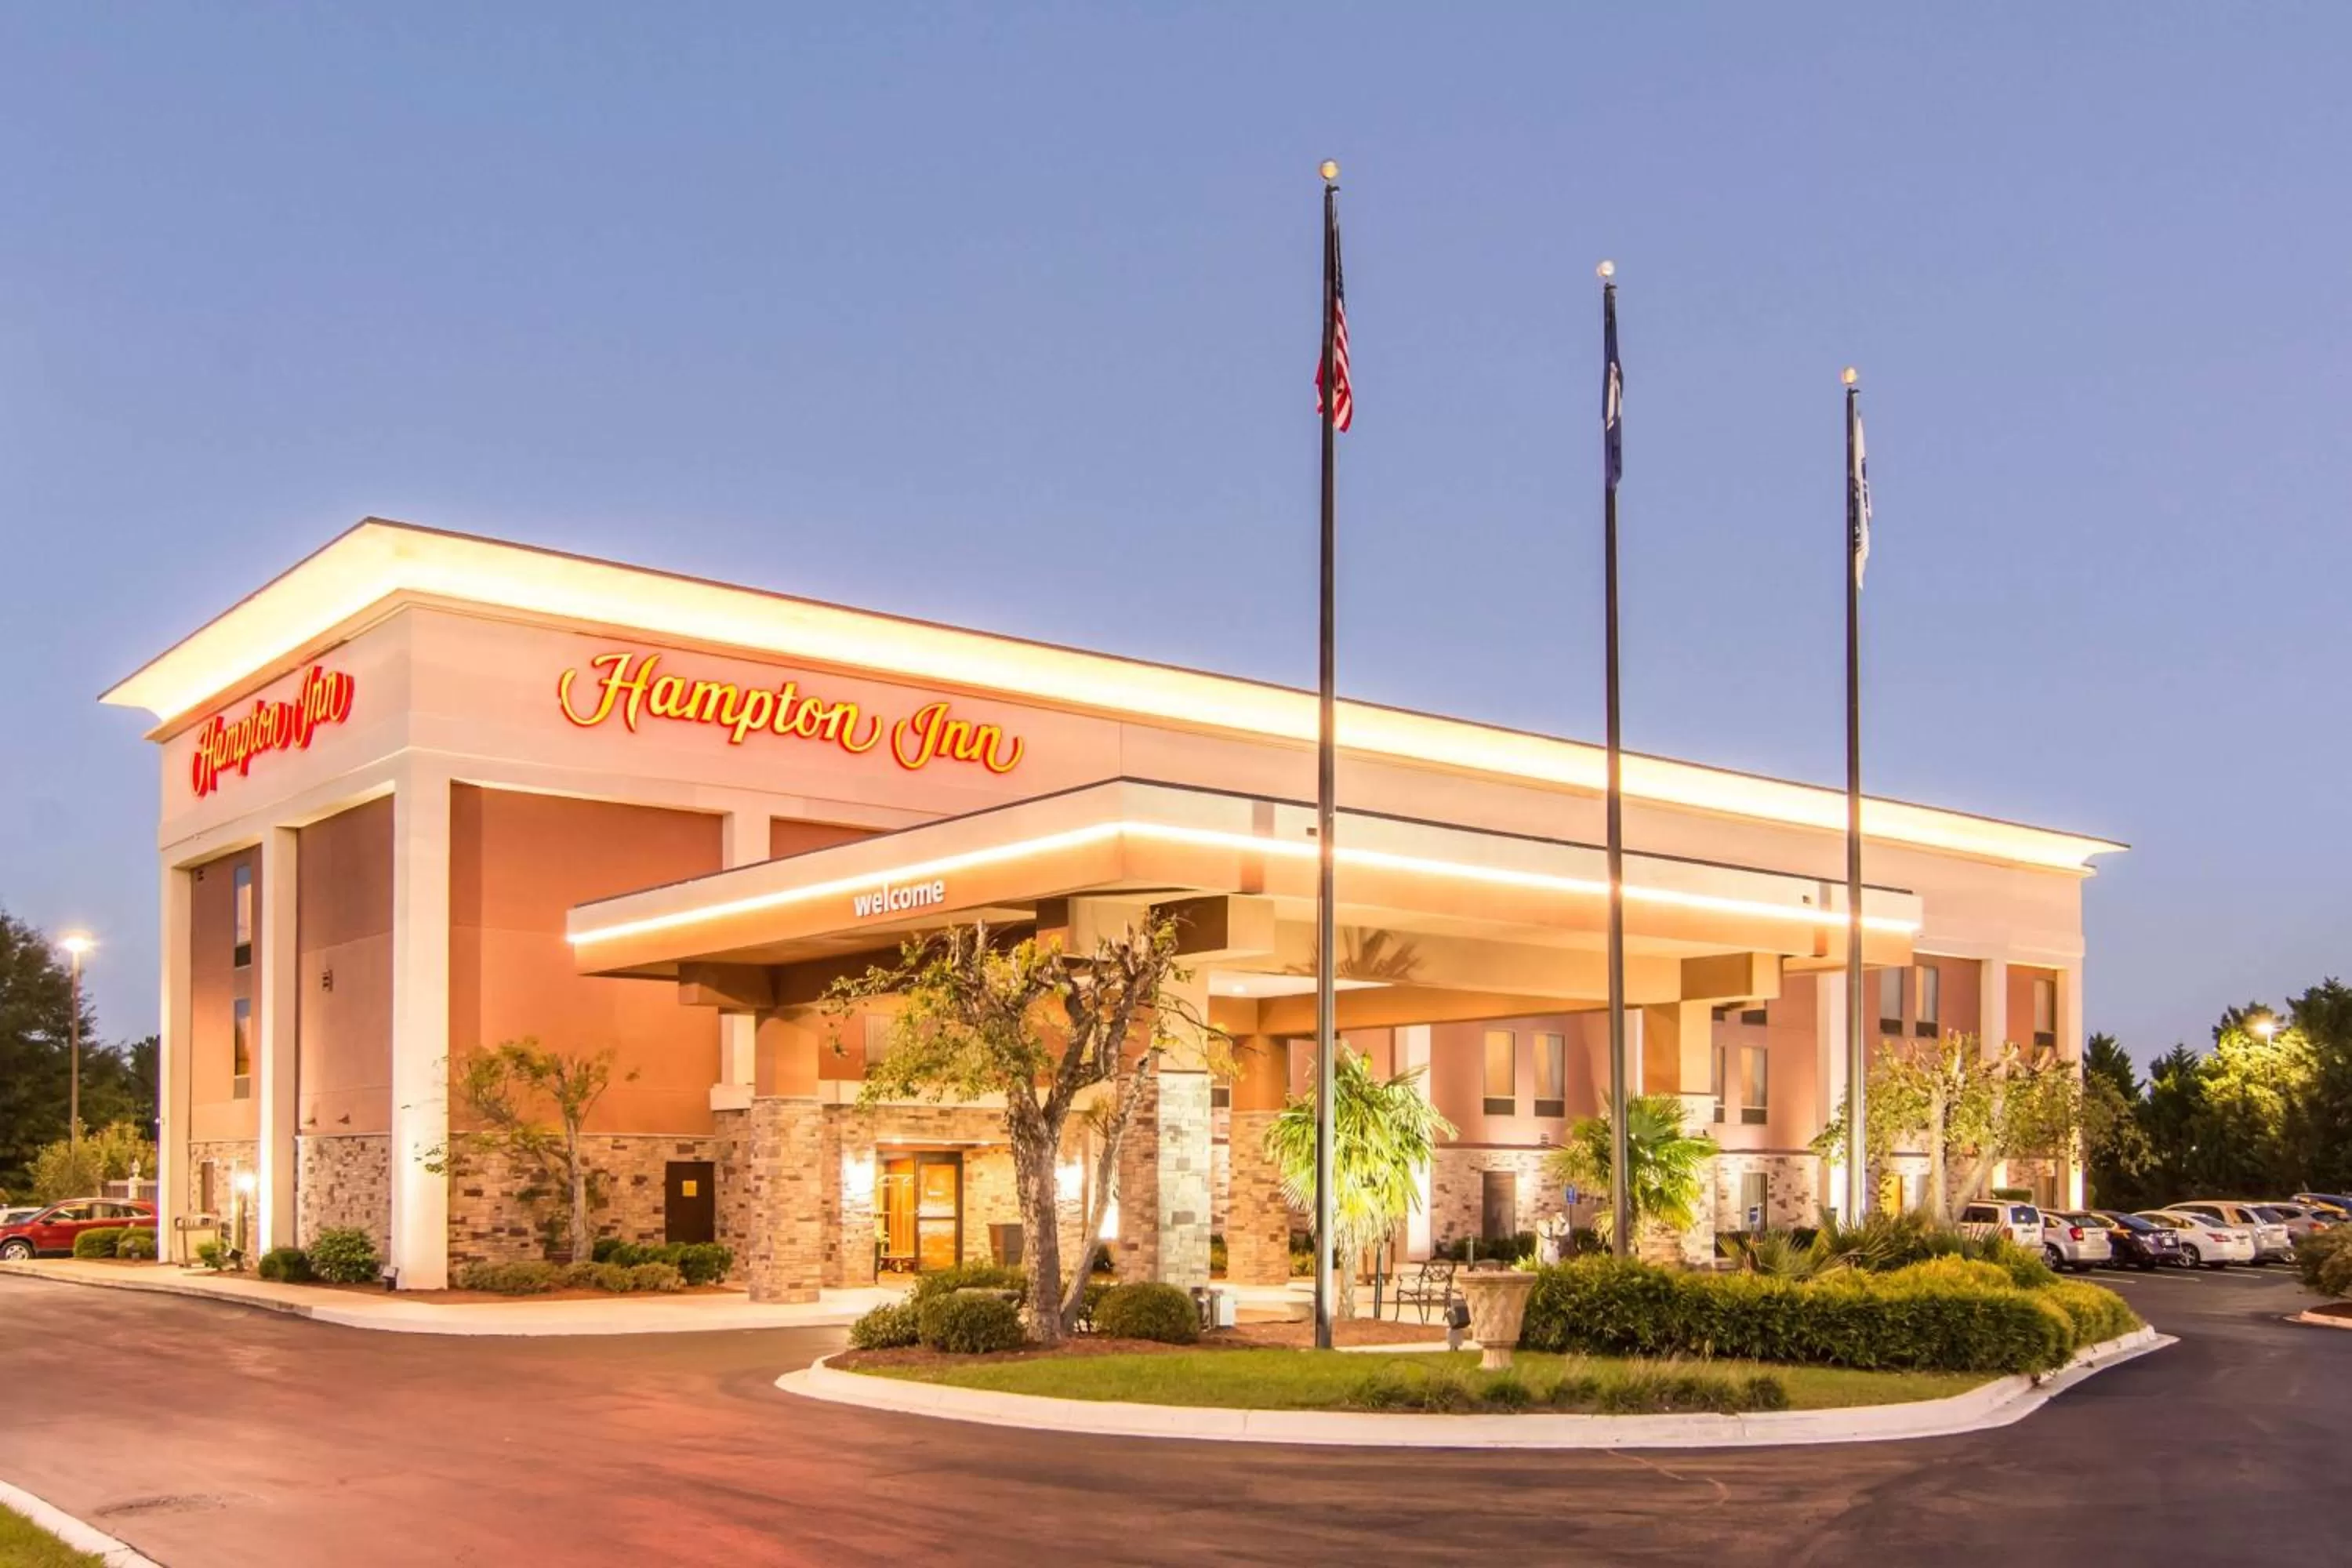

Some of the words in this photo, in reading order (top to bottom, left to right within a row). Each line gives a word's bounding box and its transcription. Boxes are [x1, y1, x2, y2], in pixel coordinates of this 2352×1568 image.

[191, 700, 292, 798] Hampton
[292, 665, 354, 750] Inn
[557, 652, 883, 753] Hampton
[891, 702, 1025, 774] Inn
[854, 880, 946, 916] welcome
